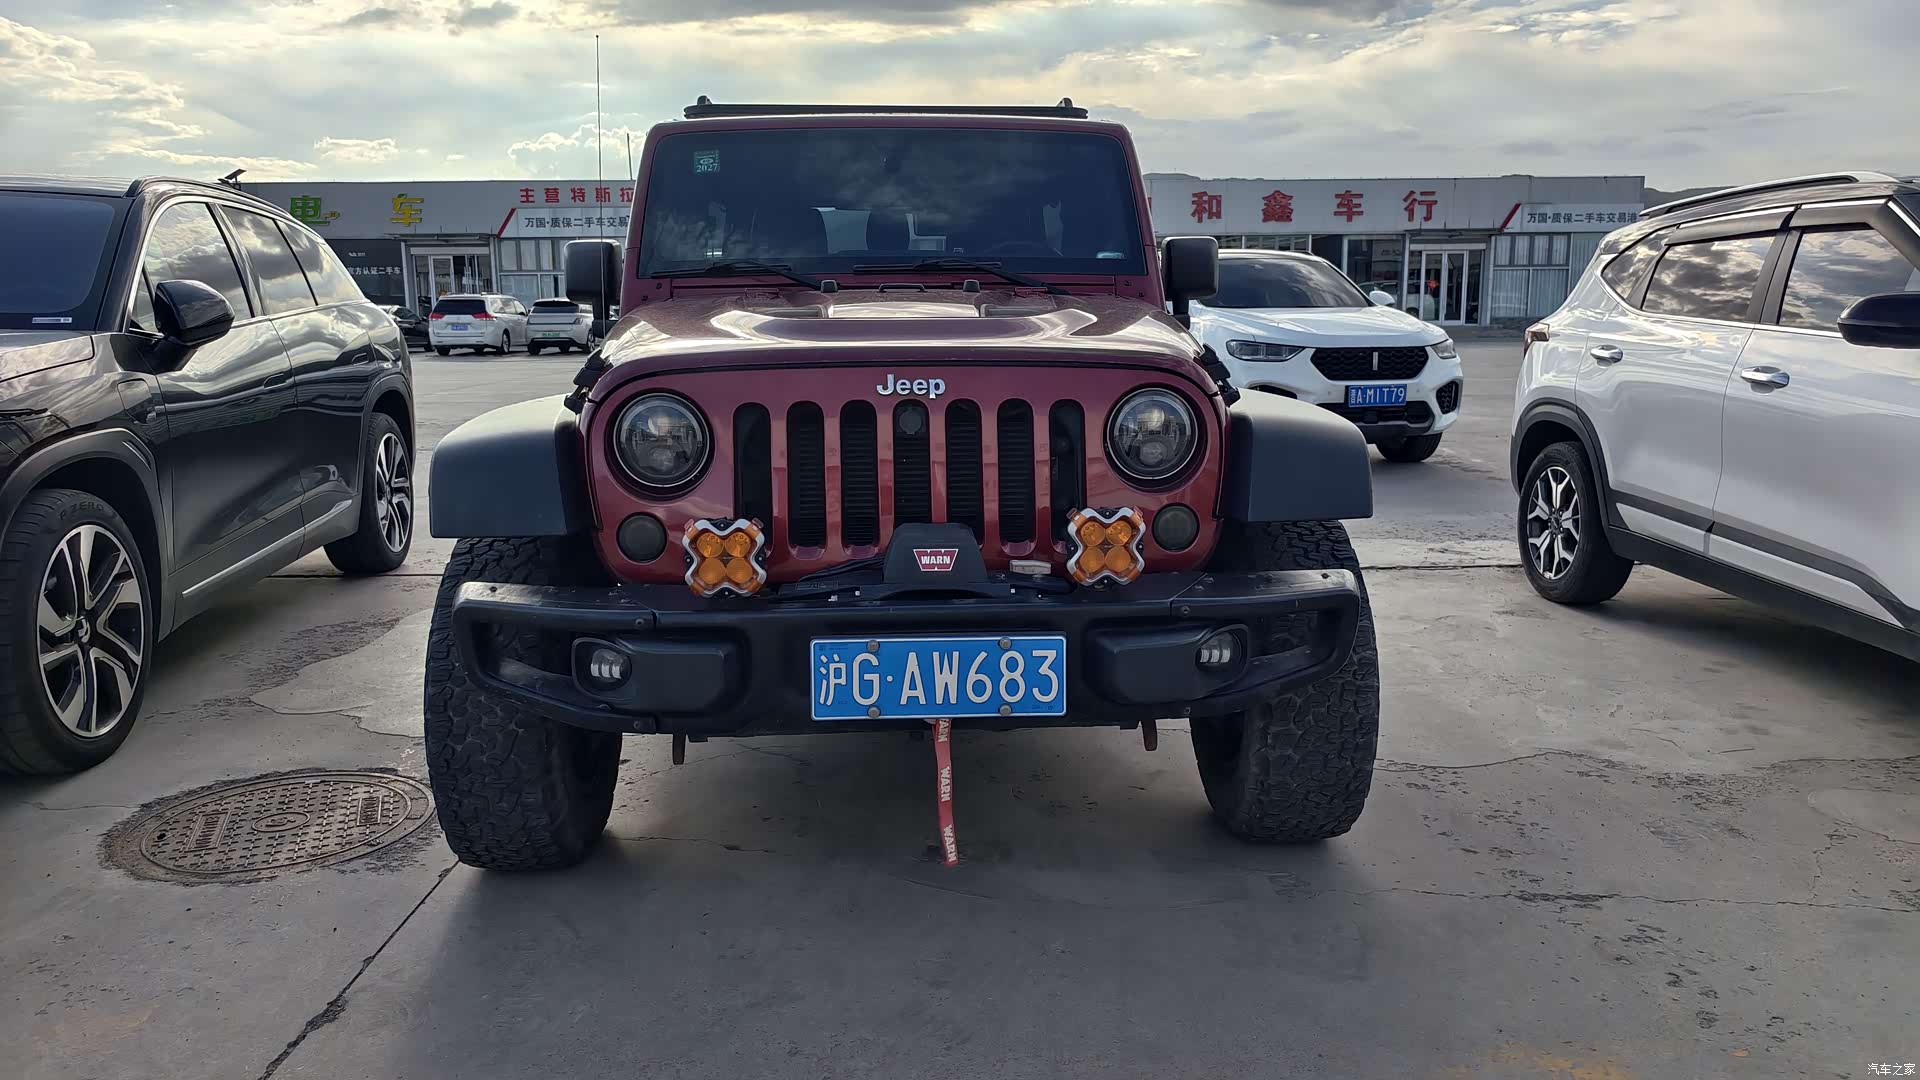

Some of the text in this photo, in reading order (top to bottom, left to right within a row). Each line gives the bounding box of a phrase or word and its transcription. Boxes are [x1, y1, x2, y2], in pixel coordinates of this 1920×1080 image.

[696, 163, 718, 172] 2027
[519, 187, 635, 203] 主营特斯拉
[1190, 189, 1438, 223] 和鑫车行
[524, 216, 629, 228] 万国·质保二手车交易
[1526, 212, 1637, 224] 万国·质保二手车交易港
[876, 373, 946, 399] Jeep
[920, 554, 951, 565] WARN
[818, 650, 1059, 706] 沪G·AW683
[940, 766, 951, 802] WARN
[943, 824, 957, 862] WARN
